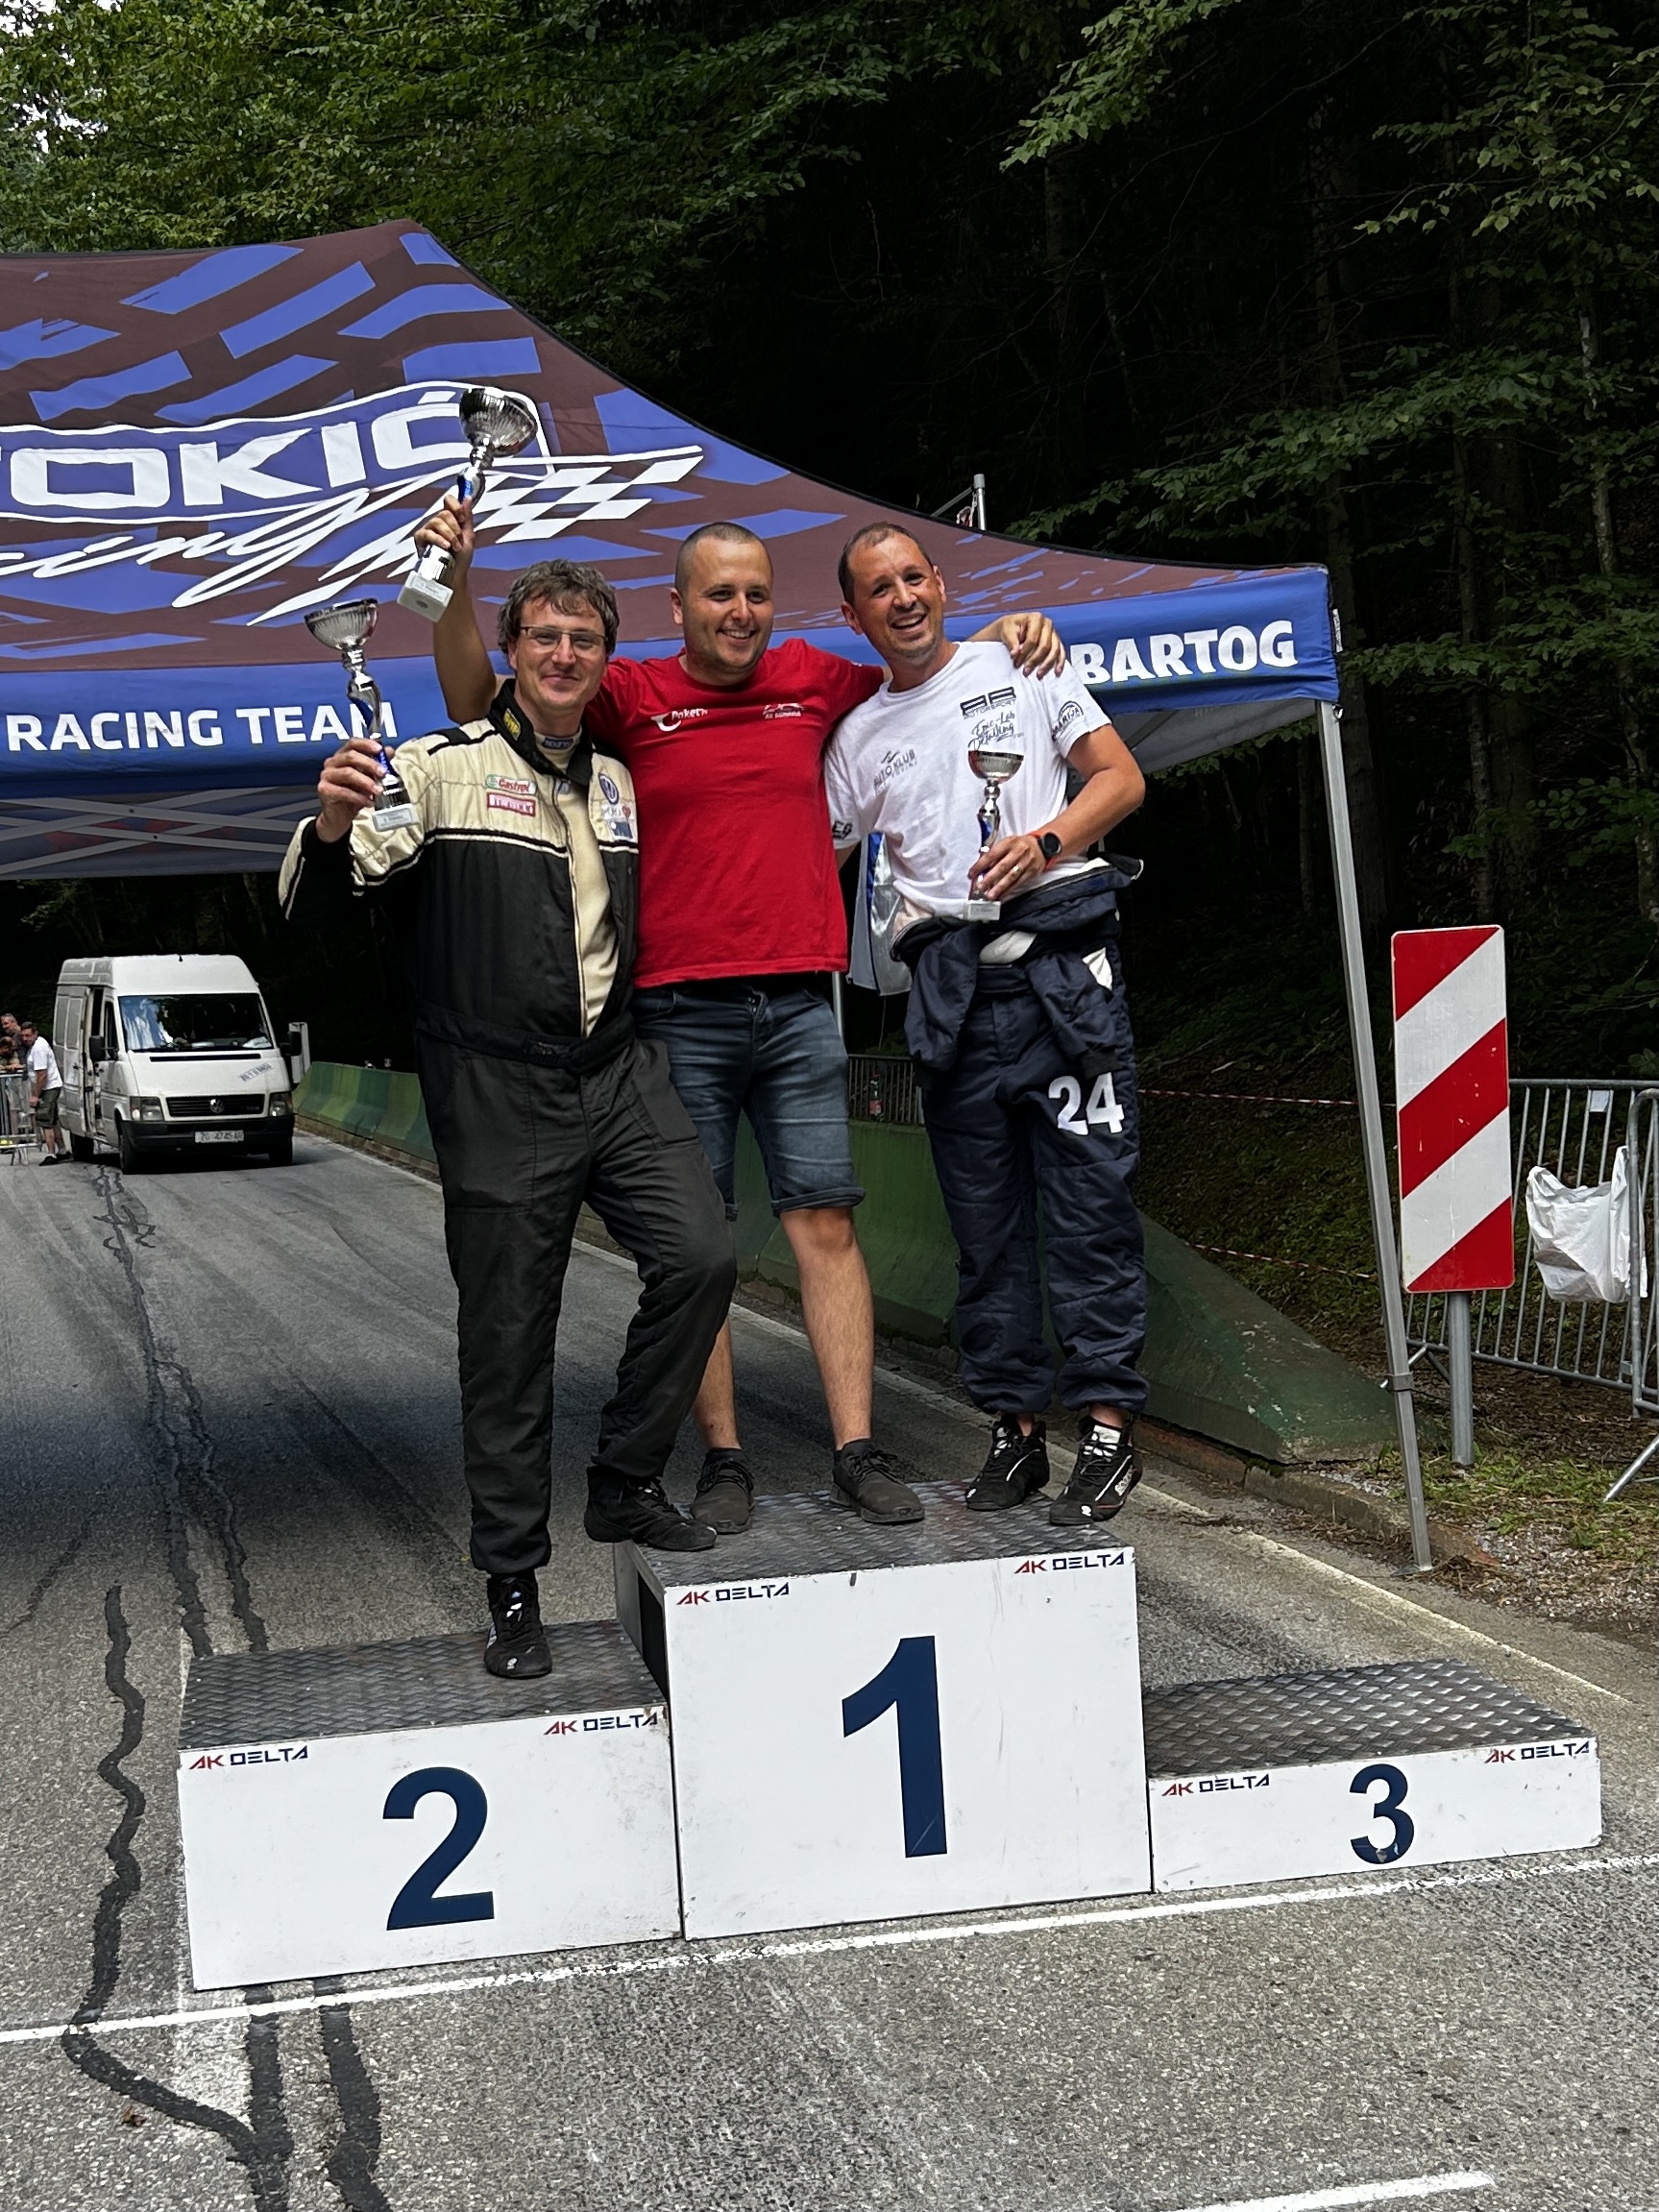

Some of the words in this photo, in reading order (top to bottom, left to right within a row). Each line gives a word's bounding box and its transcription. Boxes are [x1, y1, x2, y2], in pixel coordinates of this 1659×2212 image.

[0, 389, 474, 509] OKIĆ
[1069, 620, 1299, 685] BARTOG
[6, 709, 224, 752] RACING
[236, 702, 398, 745] TEAM
[499, 778, 531, 793] Castrol
[1048, 1072, 1125, 1135] 24
[1013, 1560, 1047, 1575] AK
[1052, 1552, 1125, 1571] DELTA
[676, 1591, 711, 1606] AK
[716, 1582, 790, 1602] DELTA
[544, 1719, 578, 1734] AK
[584, 1712, 659, 1732] DELTA
[189, 1754, 225, 1770] AK
[230, 1745, 308, 1766] DELTA
[842, 1635, 948, 1859] 1
[1483, 1749, 1517, 1764] AK
[1522, 1740, 1590, 1761] DELTA
[1161, 1782, 1194, 1797] AK
[1199, 1773, 1270, 1792] DELTA
[1349, 1763, 1415, 1864] 3
[382, 1766, 495, 1932] 2
